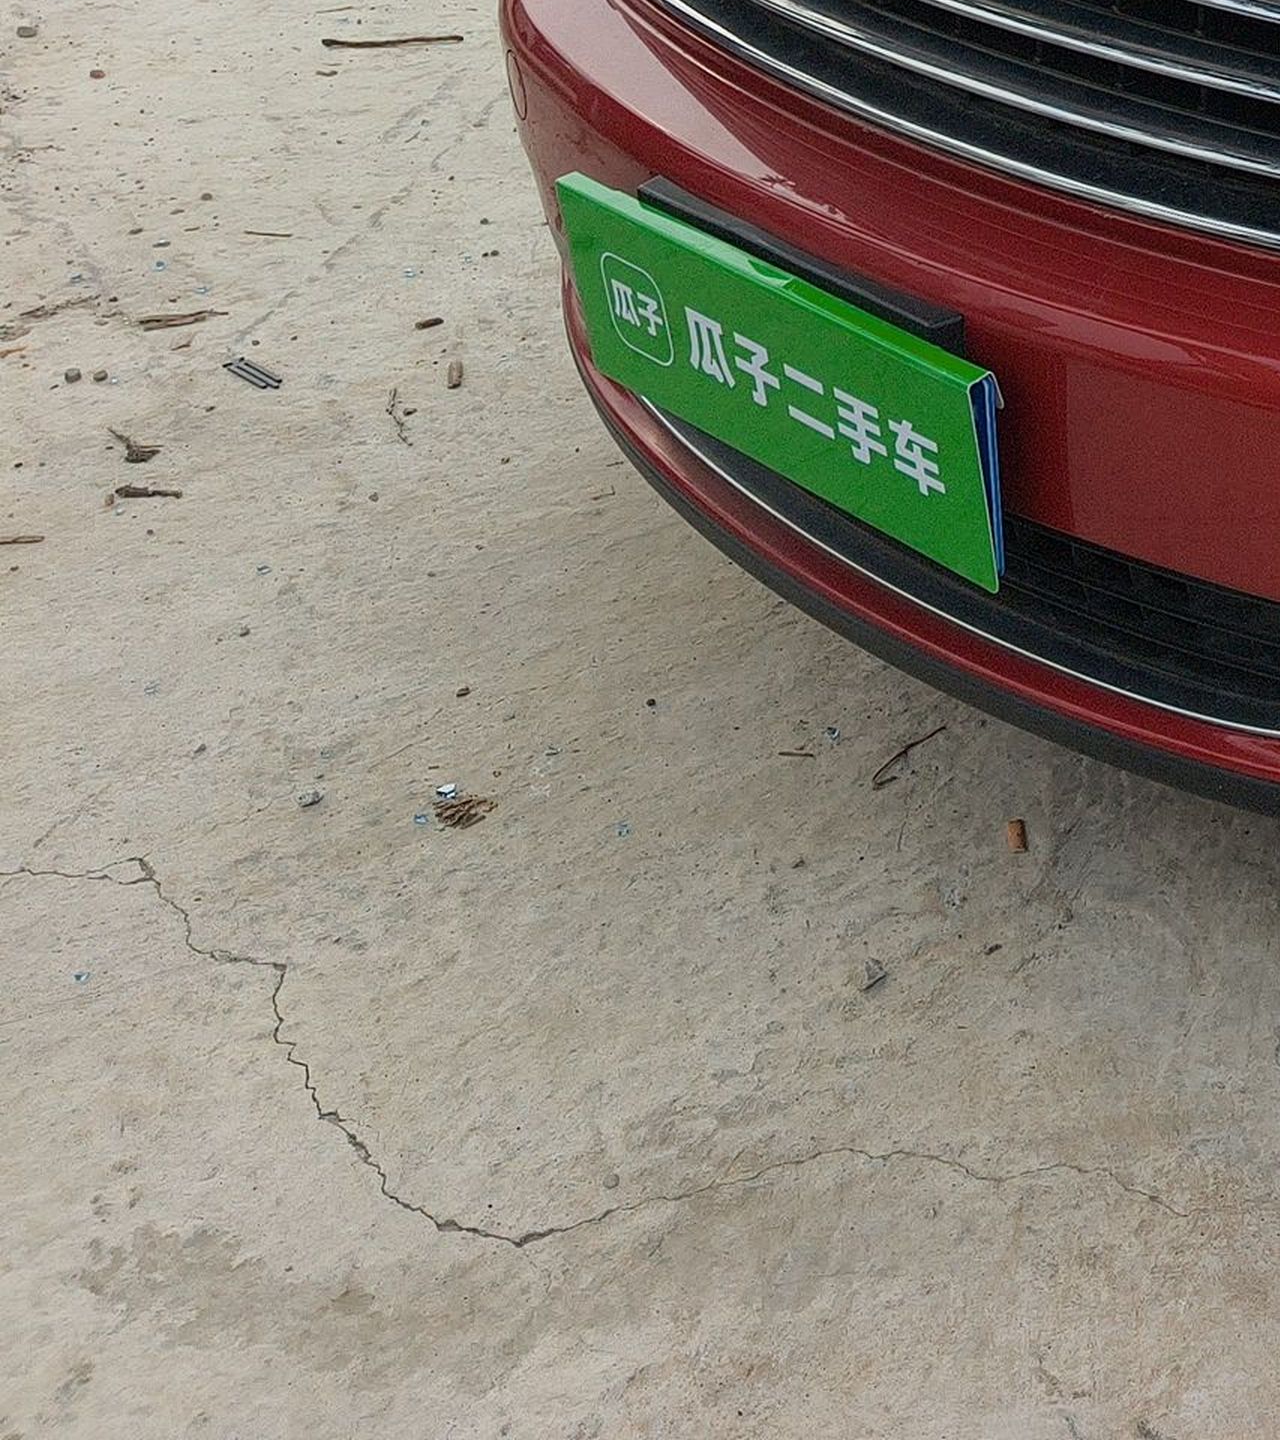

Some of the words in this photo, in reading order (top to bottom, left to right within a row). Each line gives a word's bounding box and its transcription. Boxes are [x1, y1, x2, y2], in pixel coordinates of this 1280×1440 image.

[610, 278, 663, 337] 瓜子
[684, 305, 946, 497] 瓜子二手车
